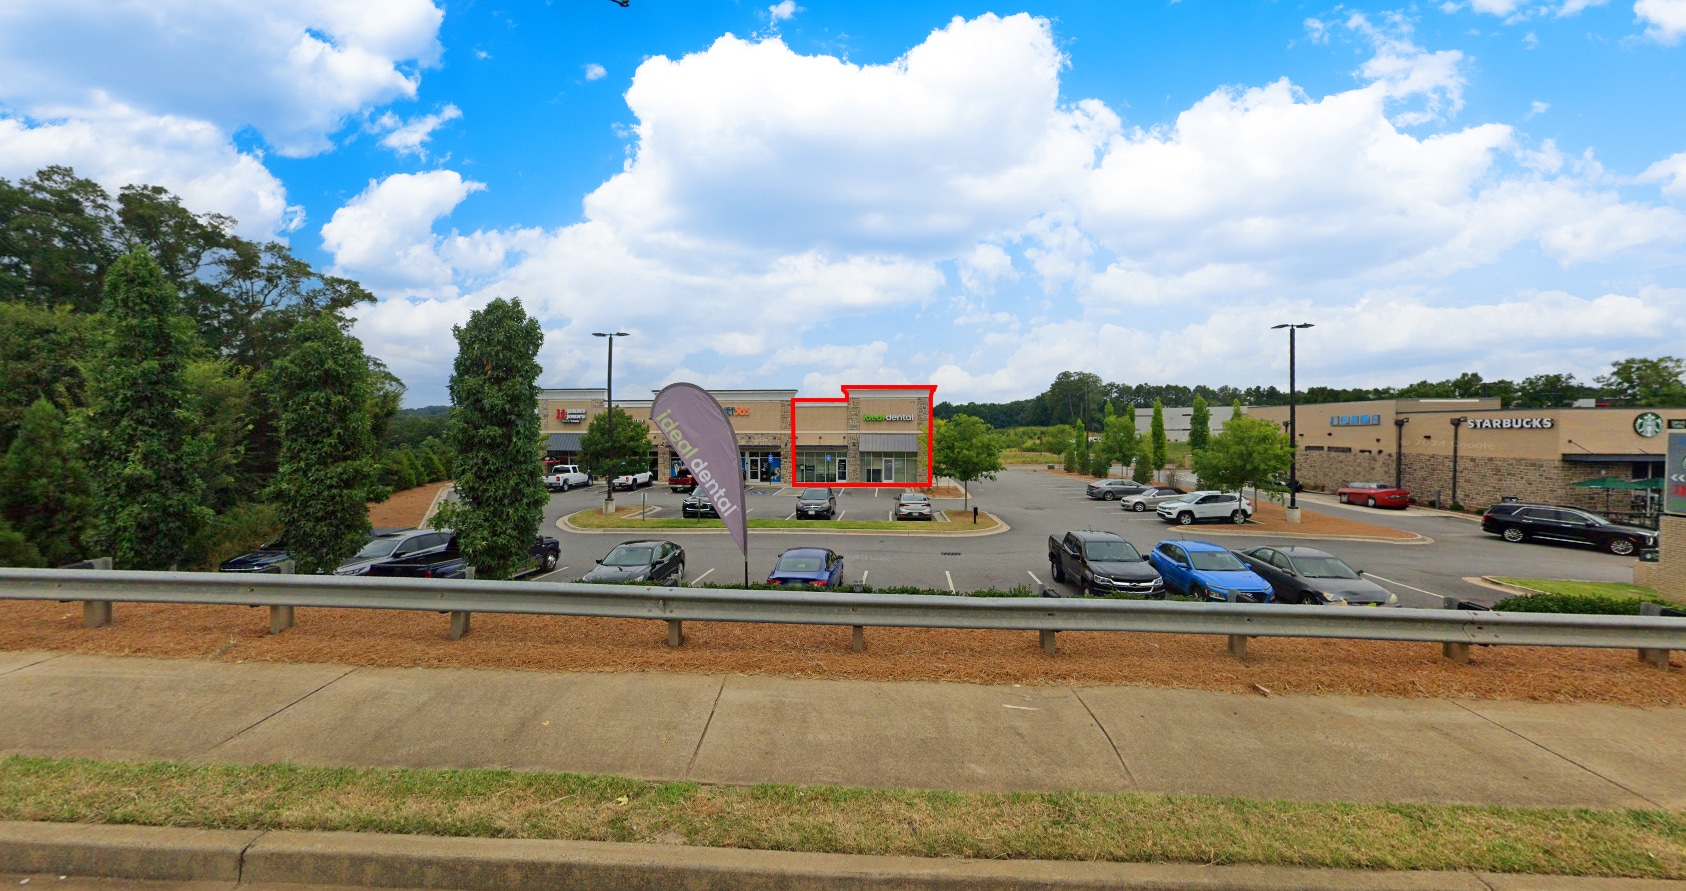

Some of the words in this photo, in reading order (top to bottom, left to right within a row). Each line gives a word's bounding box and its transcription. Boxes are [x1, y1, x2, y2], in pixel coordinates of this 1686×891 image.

[864, 413, 885, 422] ideal
[885, 412, 914, 422] dental
[1467, 418, 1553, 429] STARBUCKS
[656, 409, 699, 460] ideal
[690, 458, 738, 517] dental
